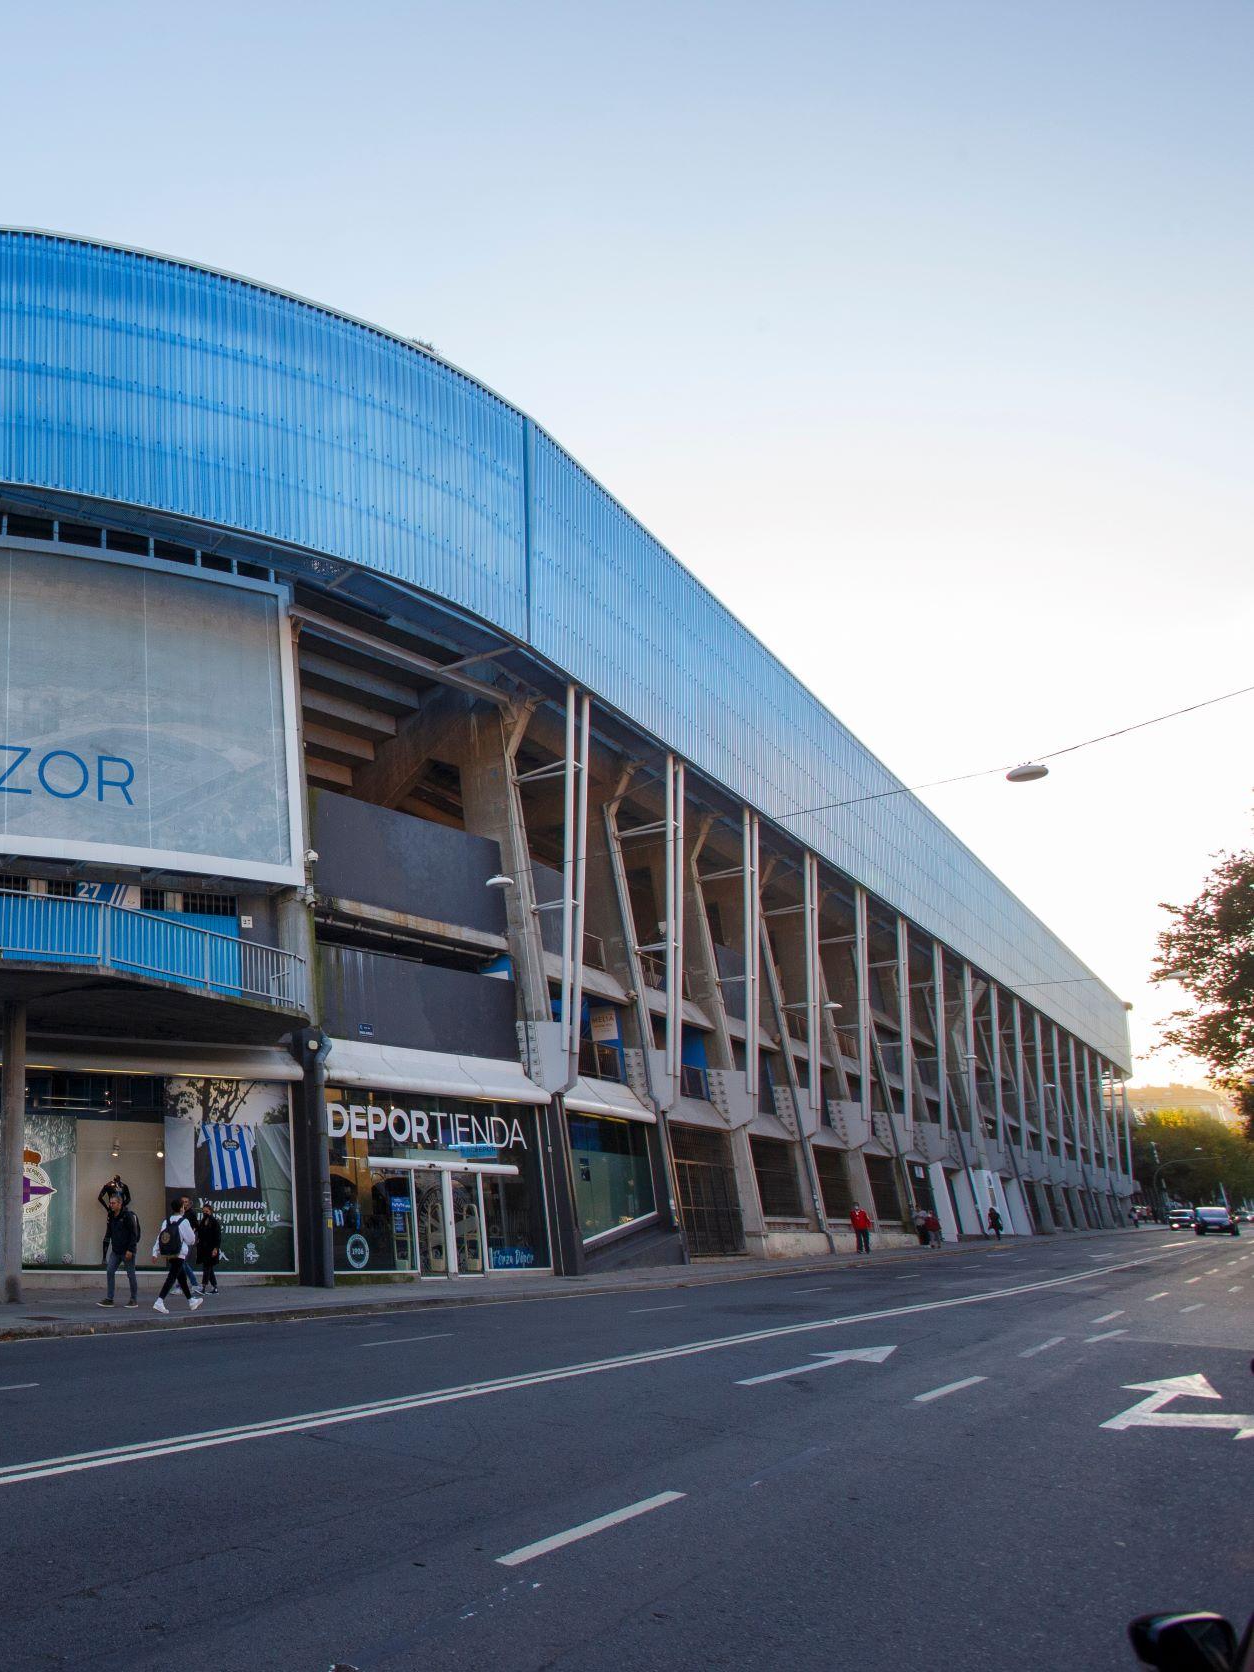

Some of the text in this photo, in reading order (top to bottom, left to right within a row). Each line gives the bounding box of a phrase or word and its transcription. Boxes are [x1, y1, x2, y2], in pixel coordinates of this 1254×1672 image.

[77, 882, 102, 898] 27
[326, 1103, 528, 1149] DEPORTIENDA
[213, 1200, 267, 1212] ganamos
[223, 1210, 266, 1223] grande
[266, 1210, 281, 1222] de
[225, 1222, 266, 1234] mundo
